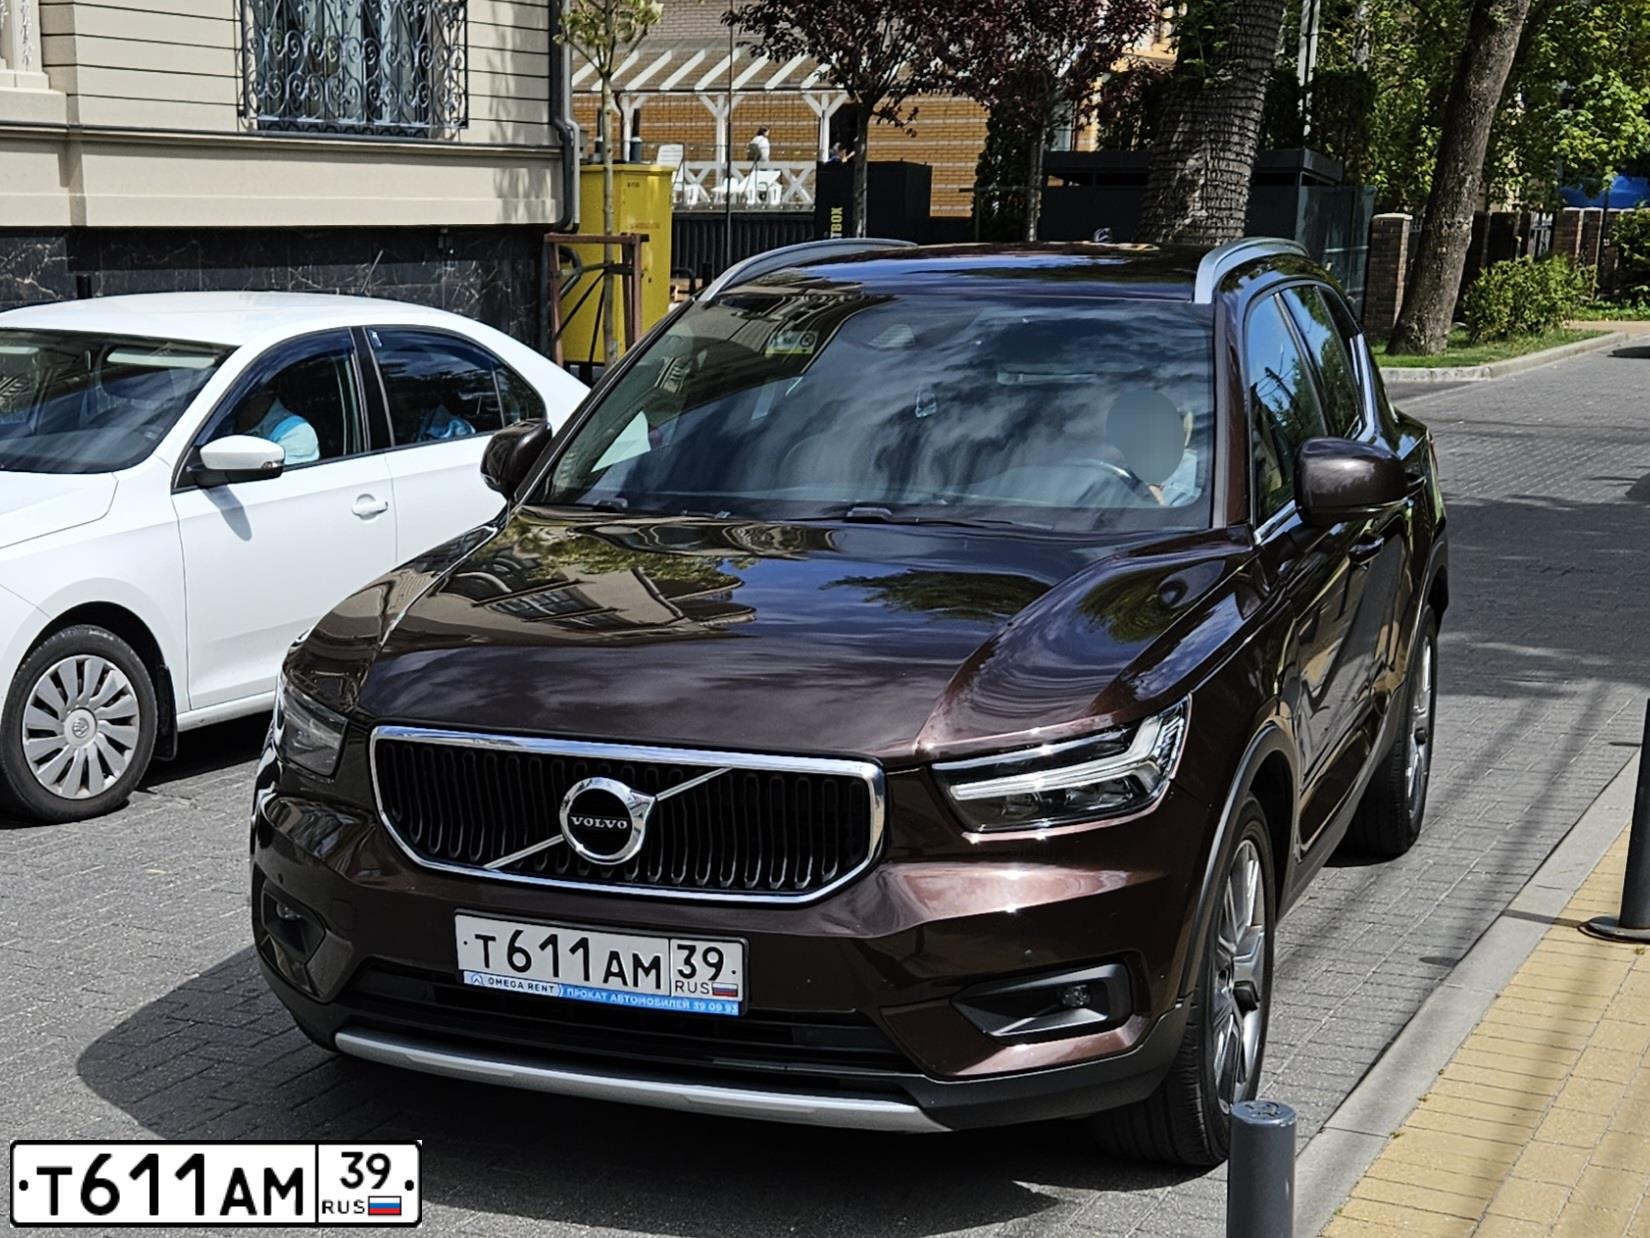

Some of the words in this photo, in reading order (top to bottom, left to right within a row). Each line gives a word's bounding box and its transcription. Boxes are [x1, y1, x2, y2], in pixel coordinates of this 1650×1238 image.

[570, 816, 628, 829] VOLVO
[474, 929, 662, 990] Т611АМ
[677, 944, 724, 981] 39
[488, 977, 524, 989] OMEGA
[527, 983, 554, 993] RENT
[675, 979, 710, 995] RUS
[567, 988, 607, 1001] ПРОКАТ
[609, 994, 690, 1010] АВТОМОБИЛЕЙ
